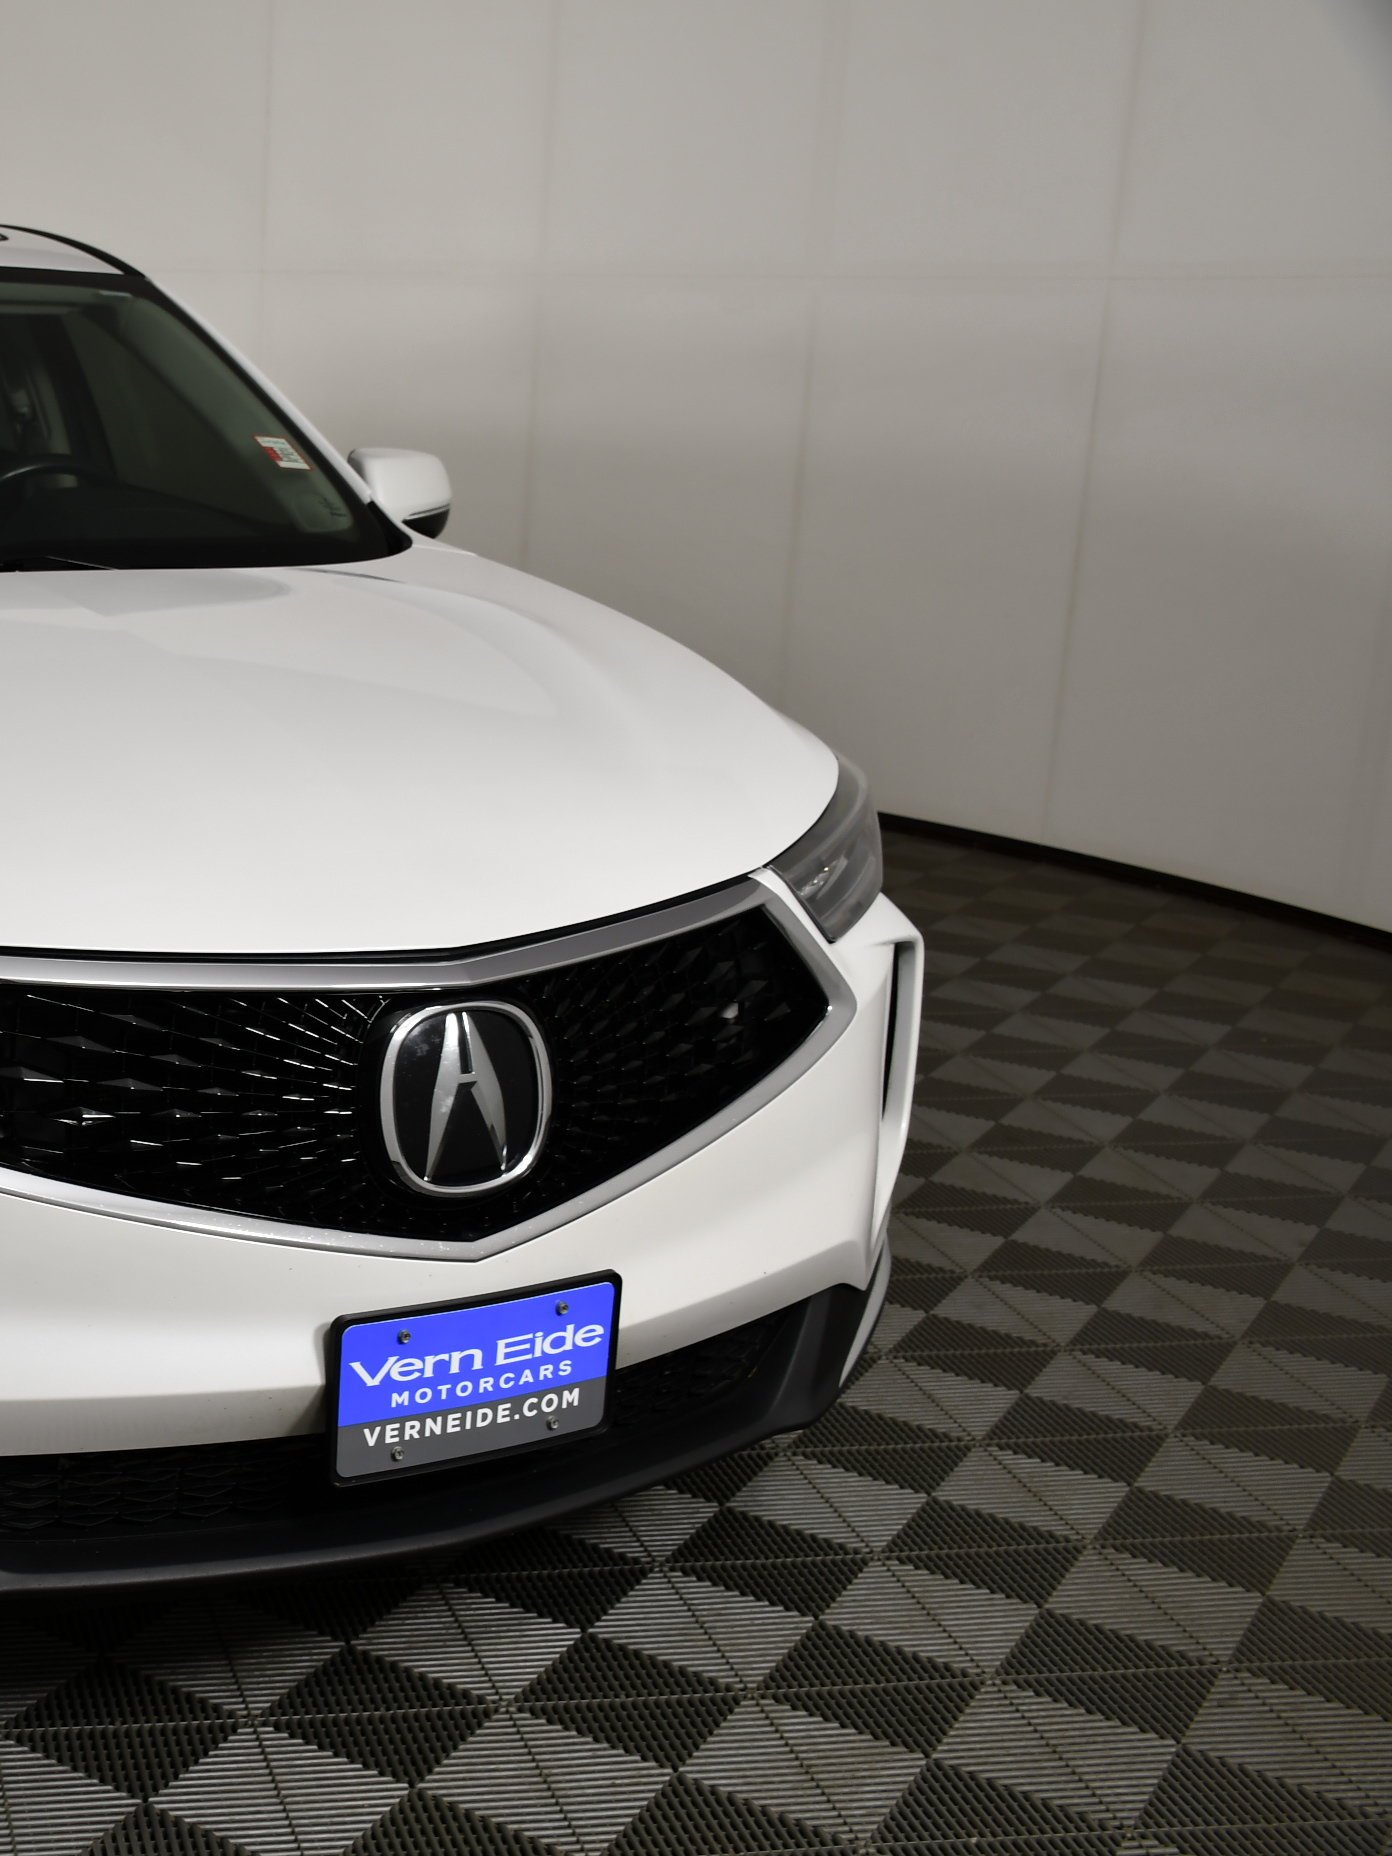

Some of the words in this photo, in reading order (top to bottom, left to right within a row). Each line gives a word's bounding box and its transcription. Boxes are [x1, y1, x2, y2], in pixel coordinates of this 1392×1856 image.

[349, 1348, 484, 1387] Vern
[494, 1324, 605, 1367] Eide
[391, 1360, 572, 1408] MOTORCARS
[363, 1387, 581, 1447] VERNEIDE.COM
